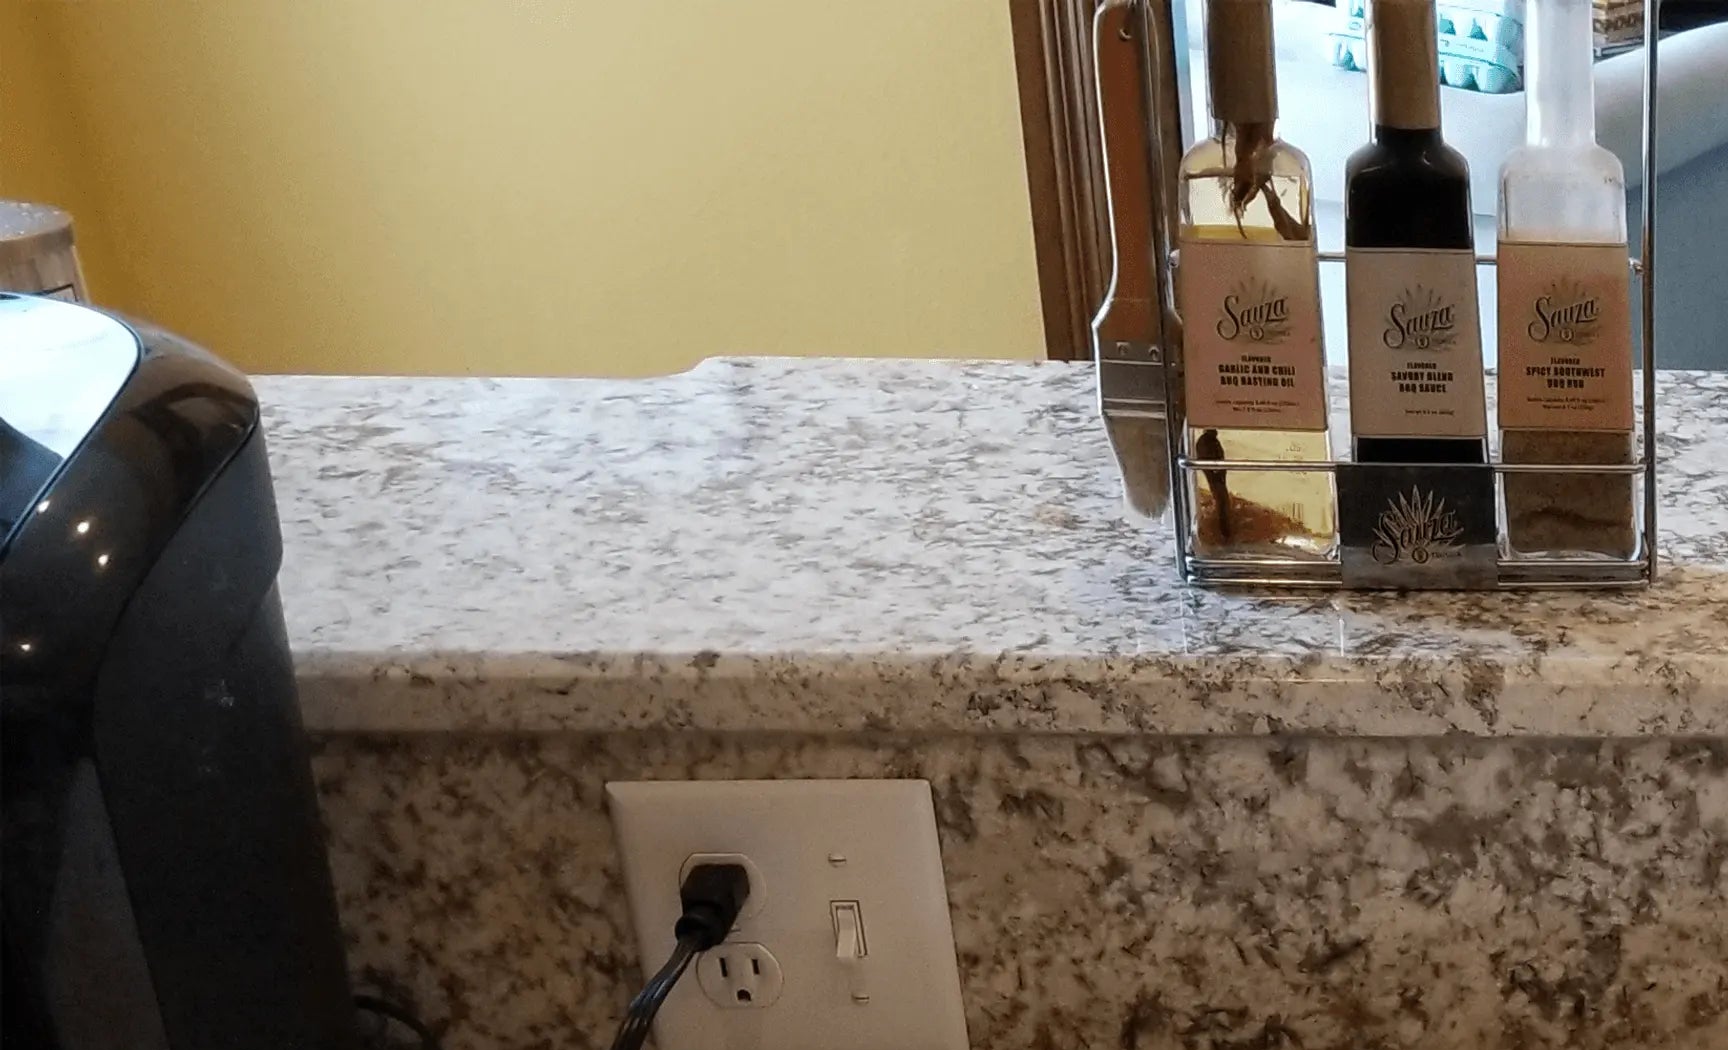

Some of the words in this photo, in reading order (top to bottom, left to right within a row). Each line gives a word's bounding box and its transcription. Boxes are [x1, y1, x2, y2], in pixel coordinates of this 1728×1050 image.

[1216, 295, 1289, 341] Sauza
[1527, 296, 1599, 342] Sauza
[1383, 303, 1455, 349] Sauza
[1218, 364, 1250, 374] GARLIC
[1252, 365, 1270, 375] AND
[1272, 366, 1296, 376] CHILI
[1391, 371, 1425, 382] SAVORY
[1426, 372, 1454, 382] BLEND
[1526, 366, 1551, 376] SPICY
[1553, 367, 1606, 378] SOUTHWEST
[1220, 375, 1239, 387] BBQ
[1281, 377, 1295, 388] OIL
[1419, 383, 1447, 393] SAUCE
[1372, 510, 1464, 565] Sauza
